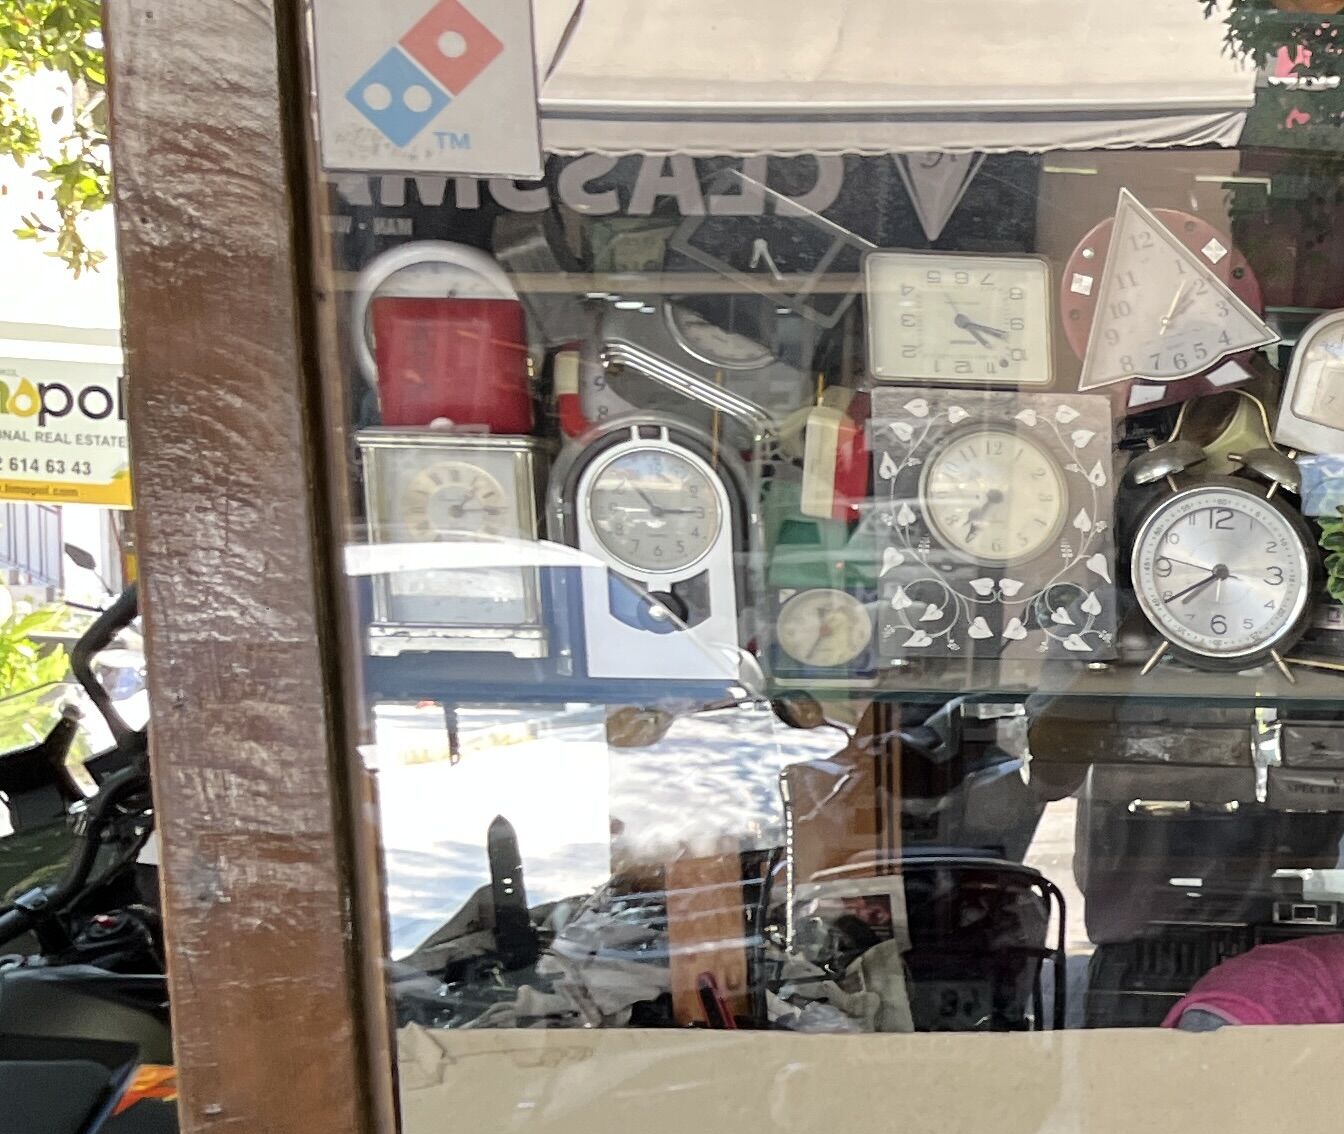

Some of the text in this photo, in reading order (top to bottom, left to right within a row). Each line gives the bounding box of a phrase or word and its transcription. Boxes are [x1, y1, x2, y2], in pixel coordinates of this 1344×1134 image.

[434, 131, 470, 150] TM
[1129, 231, 1154, 251] 12
[1175, 259, 1187, 274] 1
[1116, 271, 1139, 290] 11
[1109, 300, 1132, 320] 10
[1216, 300, 1229, 317] 3
[1104, 328, 1119, 347] 9
[1218, 330, 1232, 345] 4
[1194, 342, 1208, 360] 5
[1119, 354, 1135, 372] 8
[1149, 353, 1161, 370] 7
[1173, 353, 1188, 370] 6
[0, 430, 127, 449] NAL REAL ESTATE
[9, 457, 91, 476] 614 63 43
[1188, 514, 1196, 526] 11
[1209, 508, 1235, 530] 12
[1165, 532, 1180, 545] 10
[1265, 541, 1278, 554] 2
[653, 545, 662, 557] 6
[1155, 557, 1172, 577] 9
[1263, 566, 1284, 586] 3
[1263, 600, 1276, 610] 4
[1210, 614, 1228, 635] 6
[1242, 618, 1254, 630] 5
